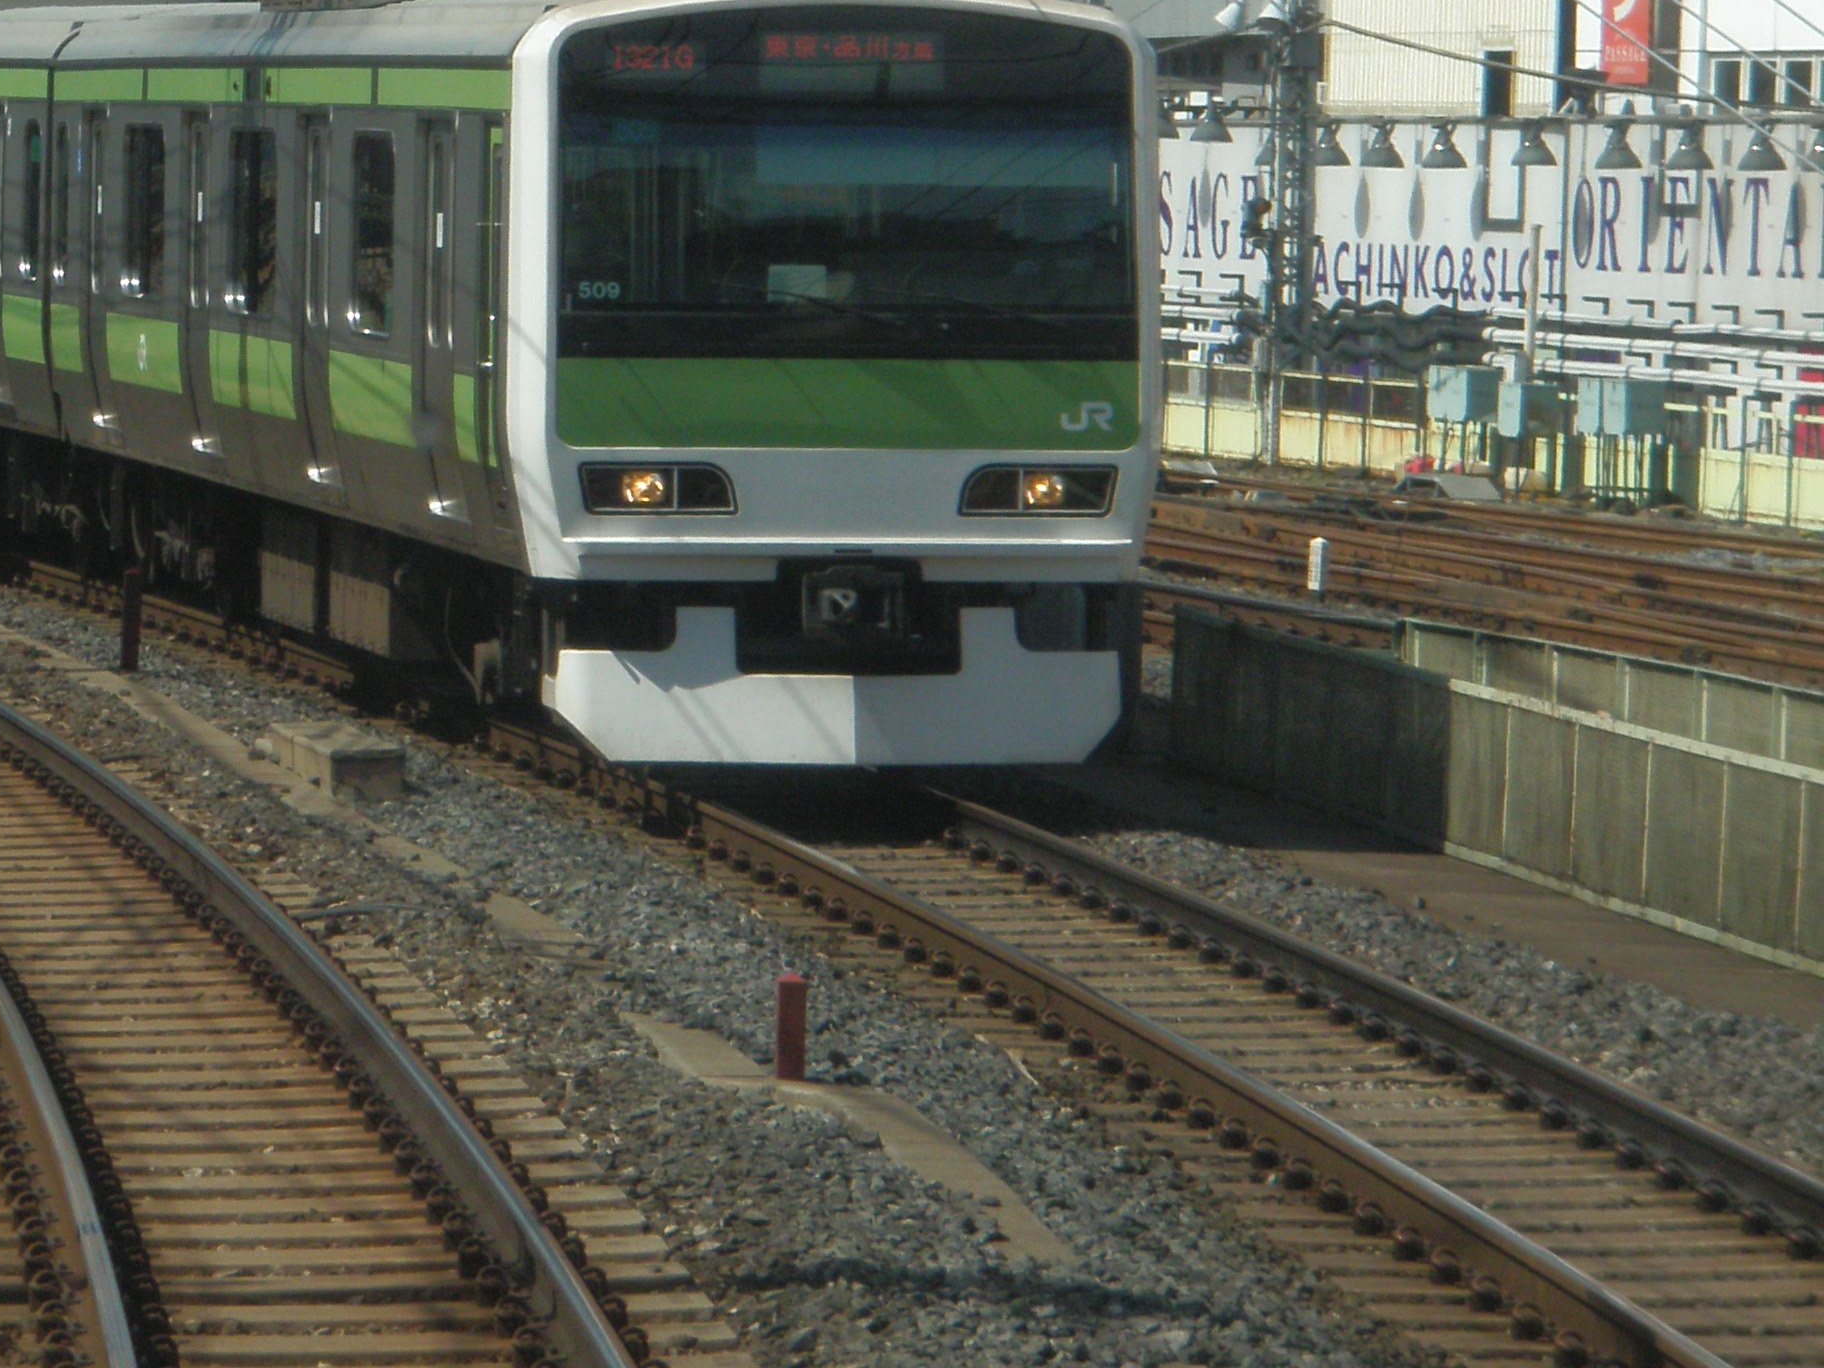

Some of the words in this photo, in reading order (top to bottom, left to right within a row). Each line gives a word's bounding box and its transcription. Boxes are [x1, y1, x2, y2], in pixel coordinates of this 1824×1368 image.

[613, 45, 694, 70] 1321G
[578, 281, 620, 299] 509
[1060, 401, 1113, 432] JR
